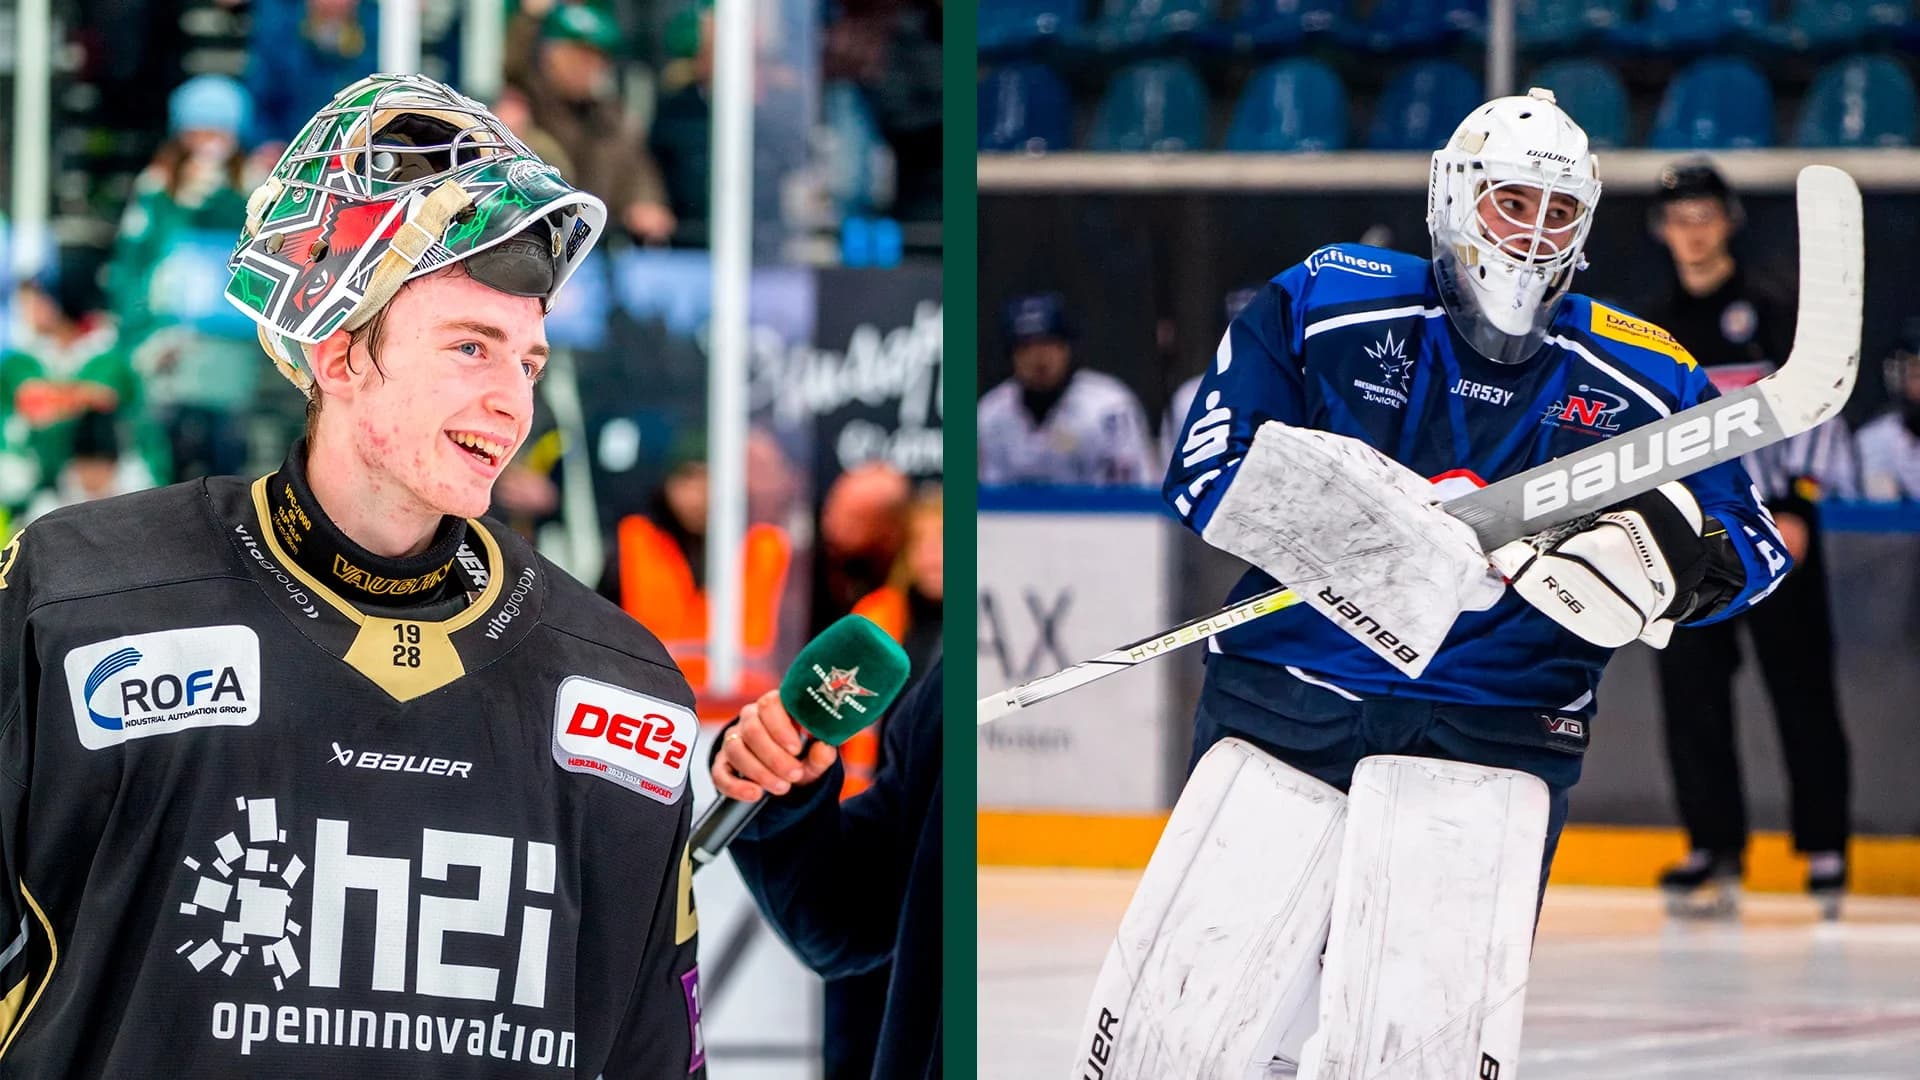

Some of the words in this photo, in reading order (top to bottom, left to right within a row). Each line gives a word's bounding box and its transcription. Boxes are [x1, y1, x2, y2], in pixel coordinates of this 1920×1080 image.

[1450, 379, 1515, 407] JER53Y
[1523, 398, 1763, 521] BAUER
[235, 524, 308, 605] vitagroup
[485, 576, 534, 640] vitagroup
[1318, 586, 1420, 664] BAUER
[393, 624, 420, 644] 19
[393, 645, 420, 668] 28
[121, 666, 245, 716] ROFA
[168, 707, 217, 721] AUTOMATION
[219, 706, 247, 714] GROUP
[356, 751, 473, 779] BAUER
[212, 1002, 575, 1068] openinnovation
